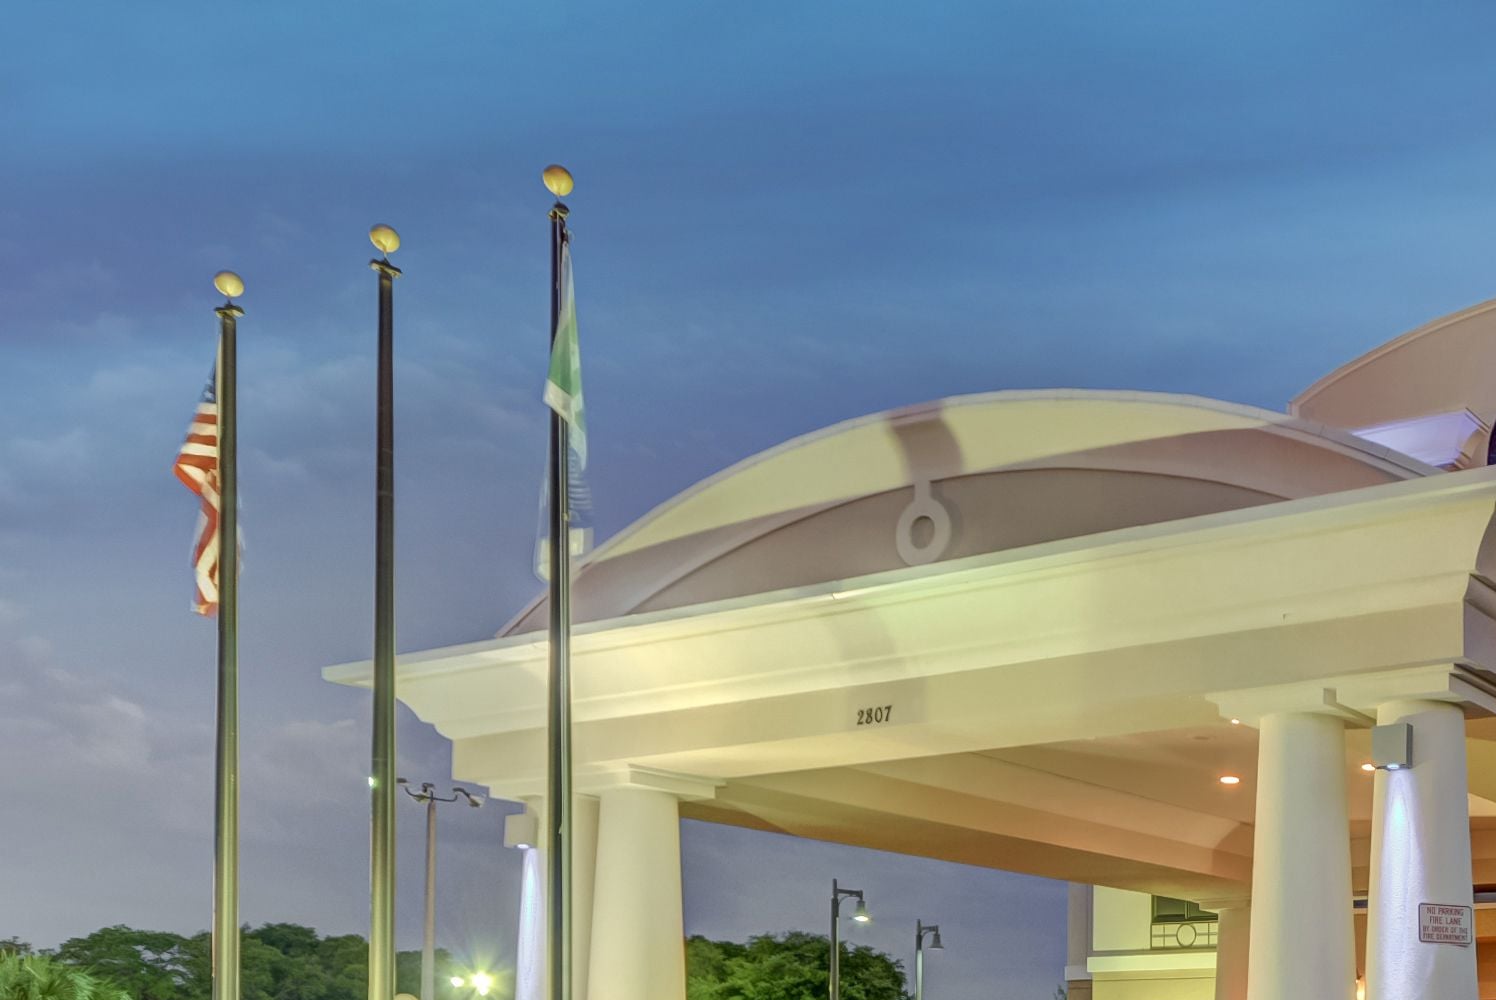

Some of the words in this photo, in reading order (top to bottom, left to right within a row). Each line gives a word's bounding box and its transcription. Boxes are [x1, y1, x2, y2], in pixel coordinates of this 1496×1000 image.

[857, 705, 892, 725] 2807
[1427, 906, 1436, 915] NO
[1438, 907, 1464, 916] PARKING
[1429, 916, 1443, 924] FIRE
[1446, 917, 1463, 926] LANE
[1432, 926, 1449, 934] ORDER
[1436, 933, 1468, 941] DEPARTMENT
